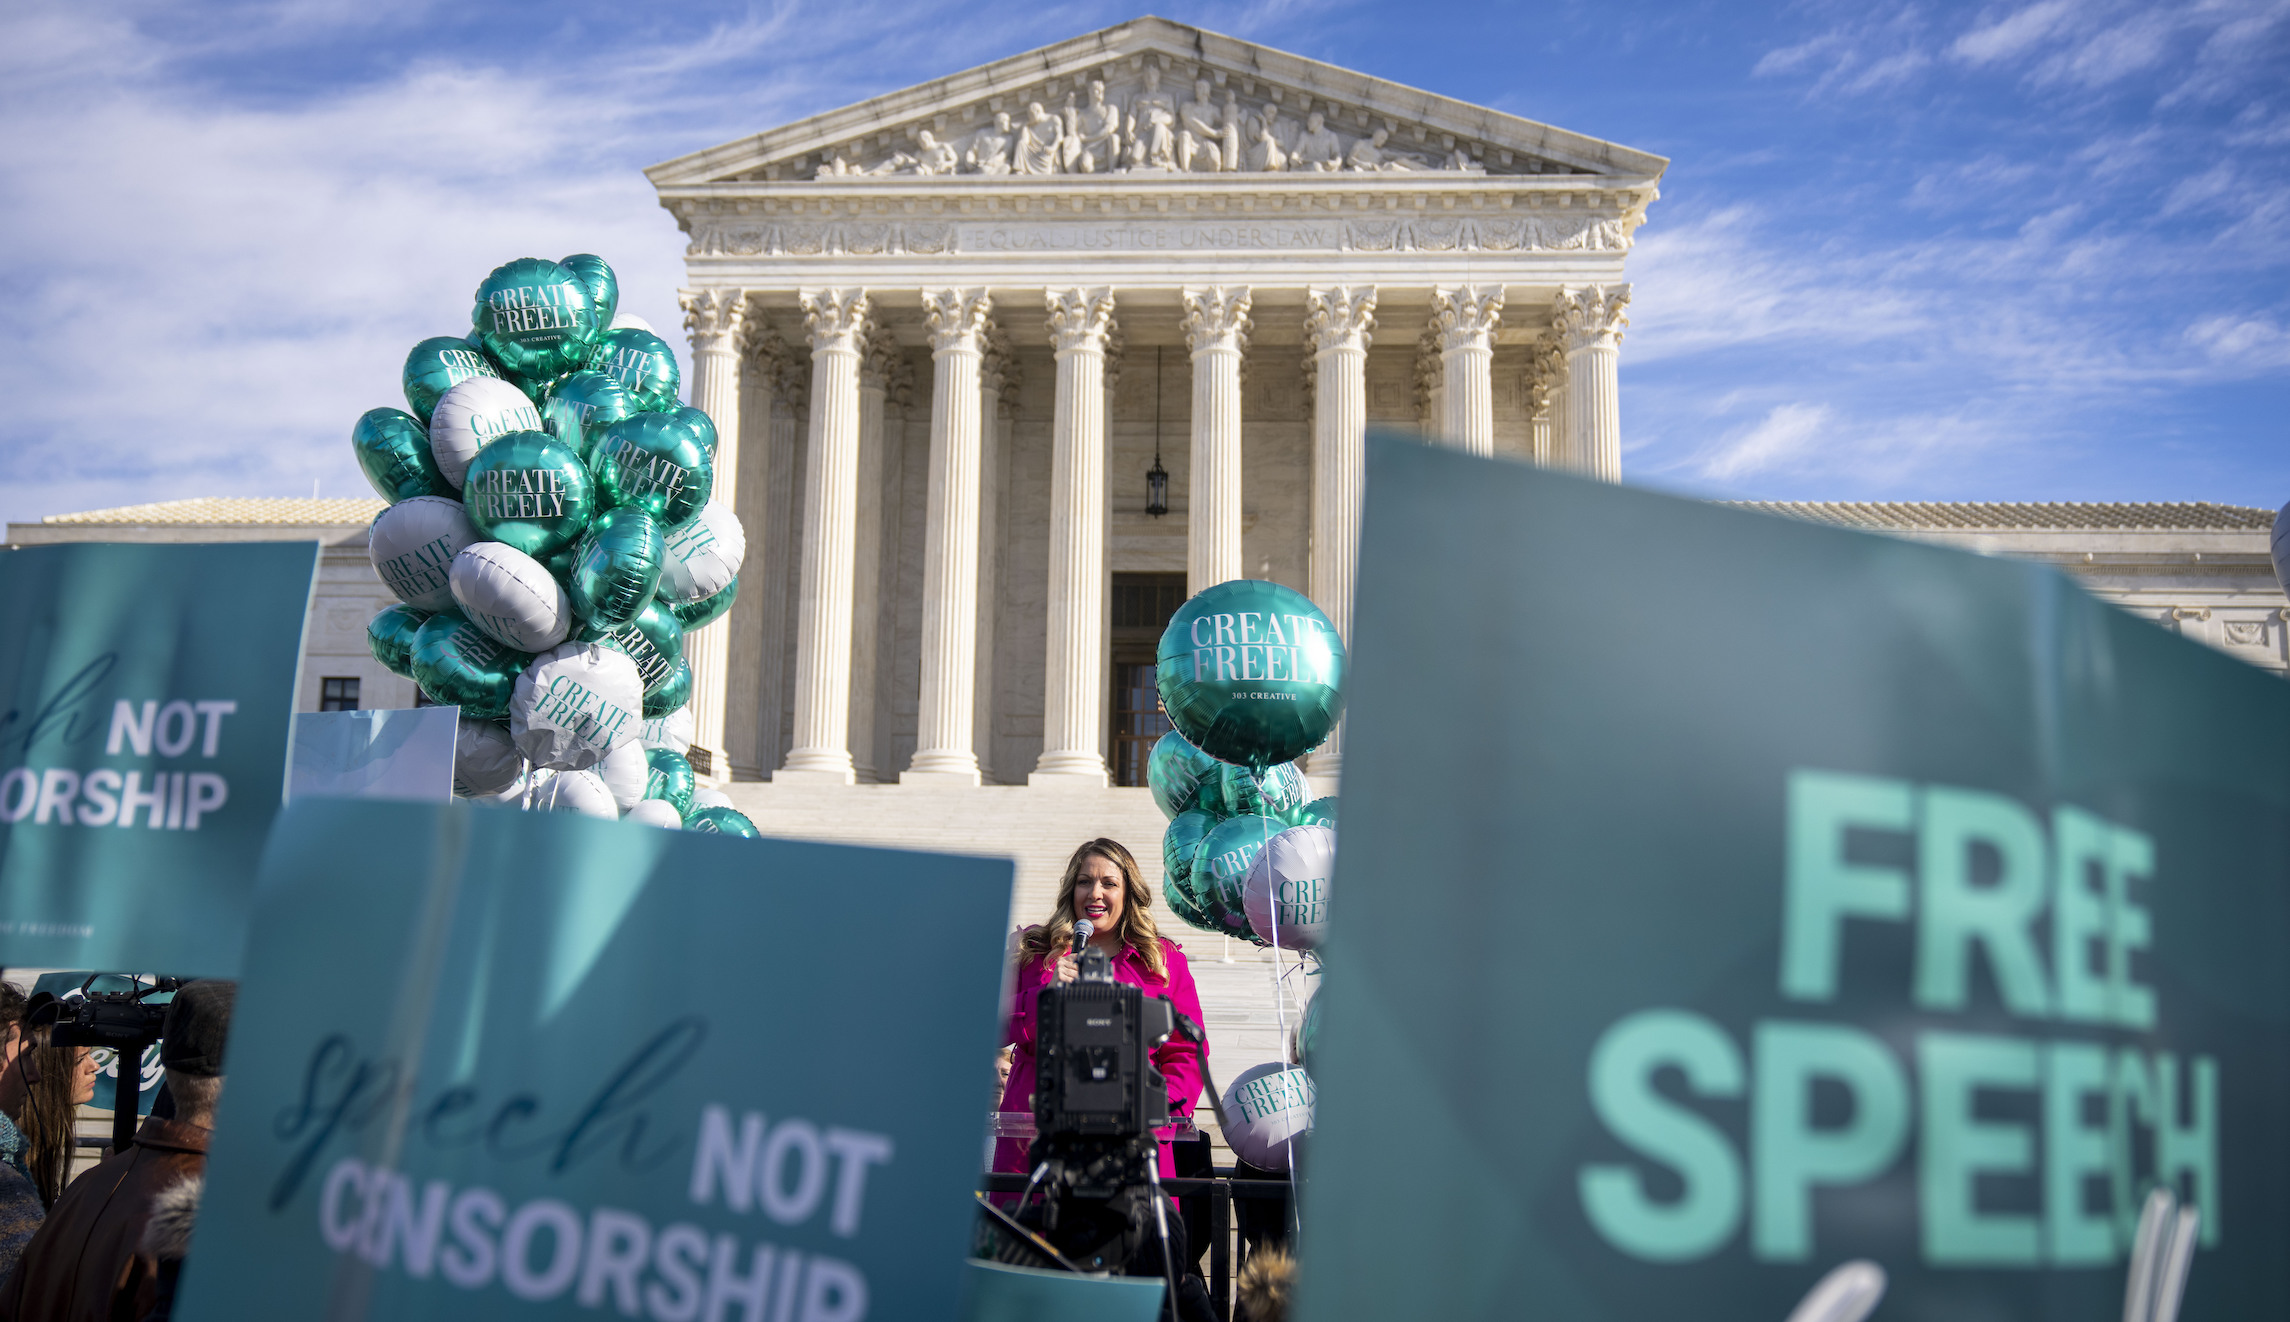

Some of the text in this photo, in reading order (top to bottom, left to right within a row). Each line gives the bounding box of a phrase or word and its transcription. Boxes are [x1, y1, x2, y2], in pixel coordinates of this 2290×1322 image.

[974, 227, 1325, 249] EQUAL JUSTICE UNDER LAW
[493, 305, 579, 335] FREELY
[531, 335, 562, 343] CREATIVE
[587, 344, 656, 374] REATE
[472, 469, 566, 494] CREATE
[595, 453, 681, 511] FREELY
[605, 435, 690, 492] CREATE
[474, 493, 566, 519] FREELY
[377, 534, 459, 583] CREATE
[534, 692, 620, 750] FREELY
[550, 675, 634, 736] CREATE
[1250, 692, 1297, 701] CREATIVE
[105, 698, 239, 758] NOT
[1778, 765, 2158, 1031] FREE
[688, 1103, 895, 1240] NOT
